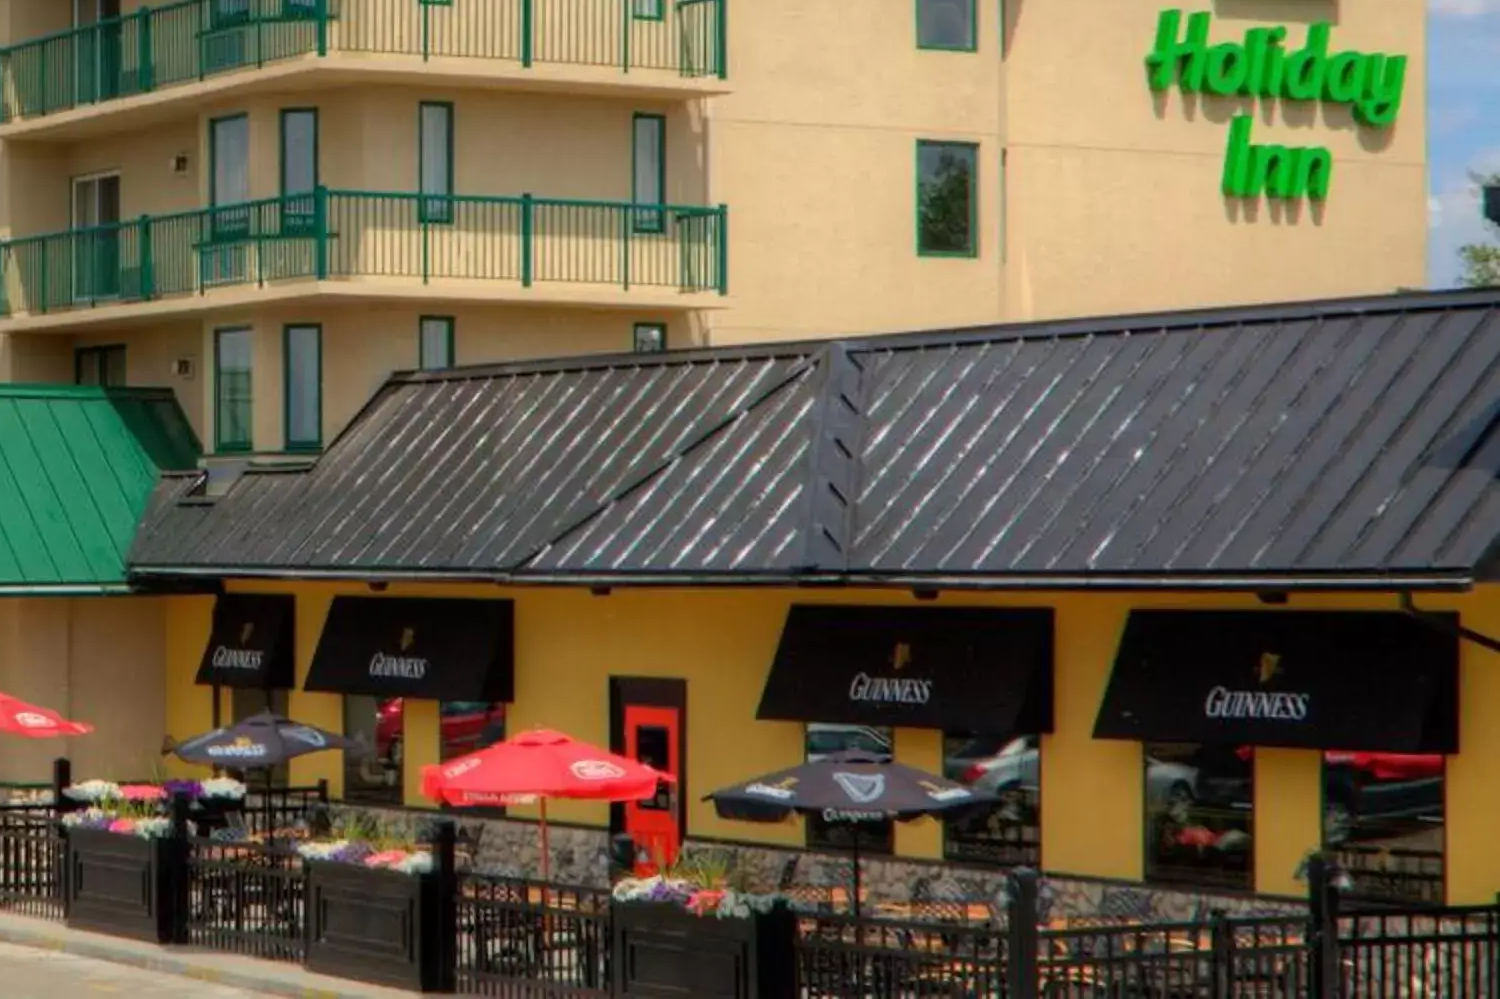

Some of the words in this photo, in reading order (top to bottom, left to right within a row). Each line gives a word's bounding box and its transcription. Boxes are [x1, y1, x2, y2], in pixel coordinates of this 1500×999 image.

[1145, 9, 1408, 127] Holiday
[1221, 115, 1332, 199] Inn
[212, 645, 264, 670] GUINNESS
[369, 652, 429, 679] GUINNESS
[849, 671, 932, 704] GUINNESS
[1206, 685, 1310, 720] GUINNESS
